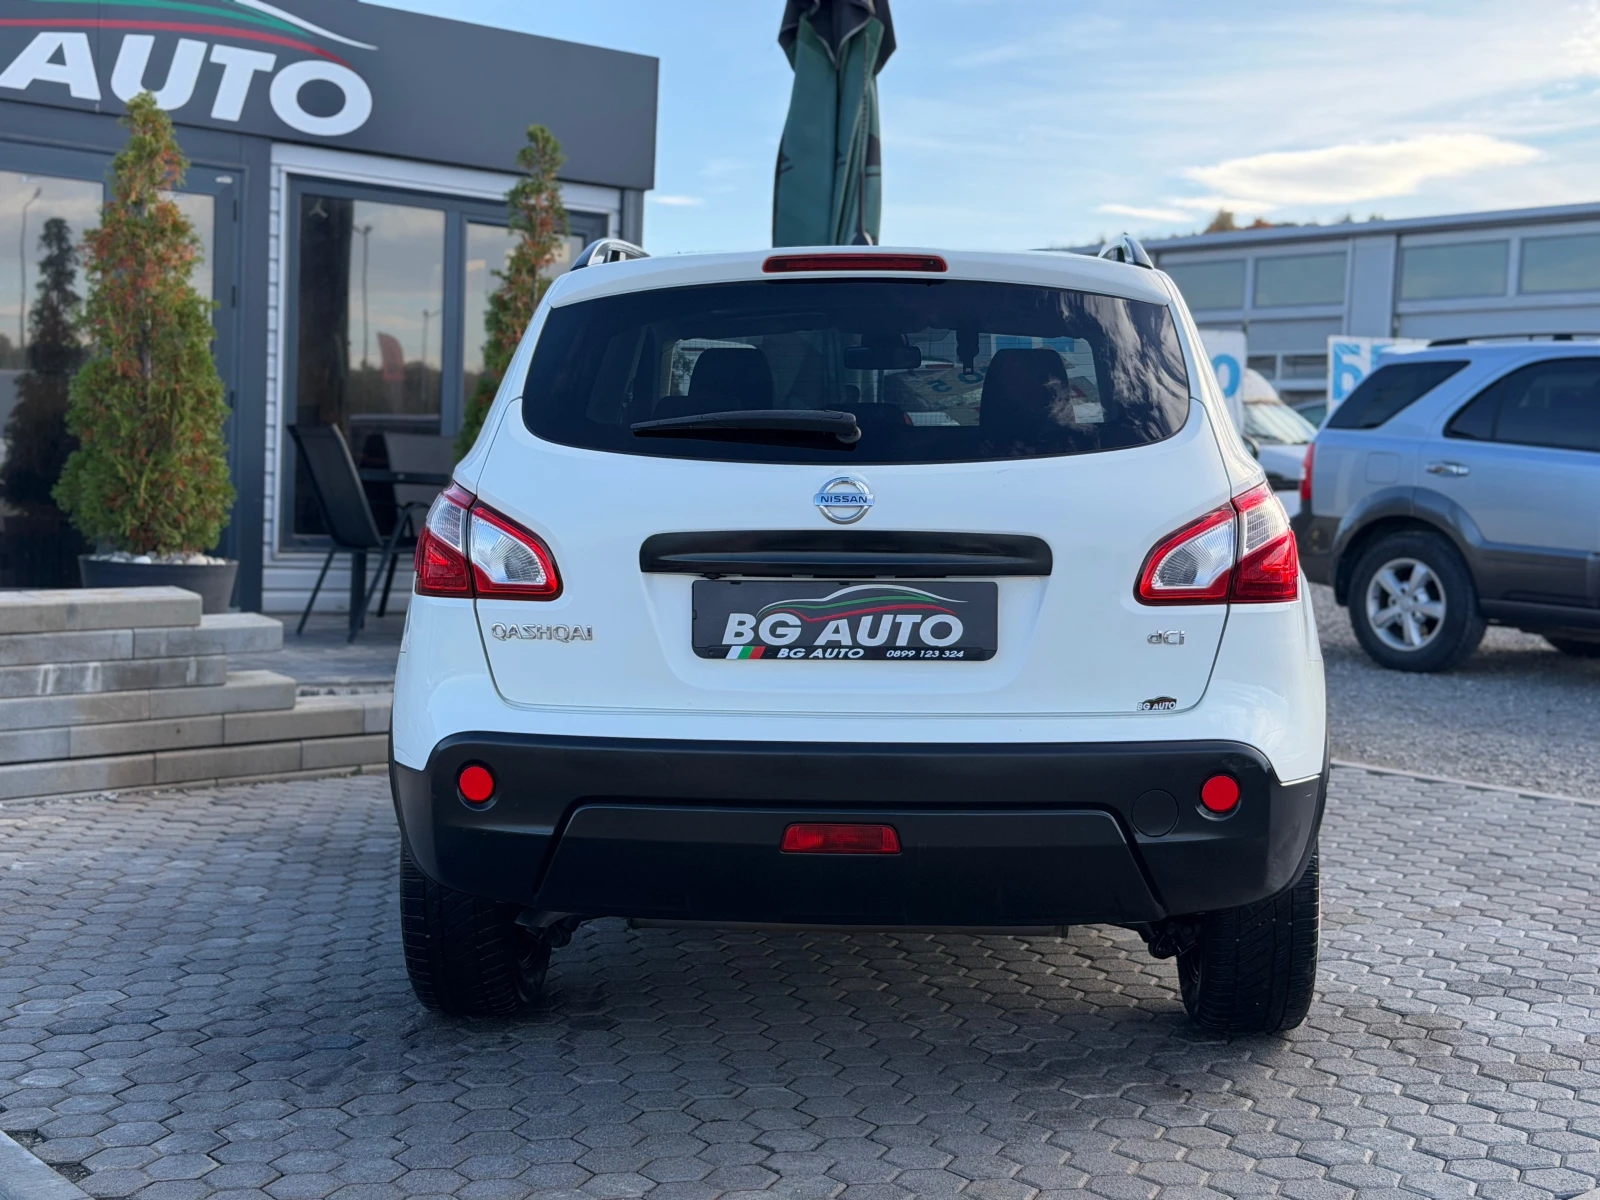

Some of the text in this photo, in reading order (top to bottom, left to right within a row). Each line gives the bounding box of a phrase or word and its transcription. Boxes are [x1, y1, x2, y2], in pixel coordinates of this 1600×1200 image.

[0, 31, 373, 137] AUTO
[820, 495, 868, 504] NISSAN
[491, 621, 593, 644] QASHQAI
[721, 612, 964, 648] BG AUTO
[1146, 629, 1185, 646] dCi
[777, 647, 965, 659] BG AUTO 0899 123 324
[1137, 701, 1177, 711] BG AUTO
